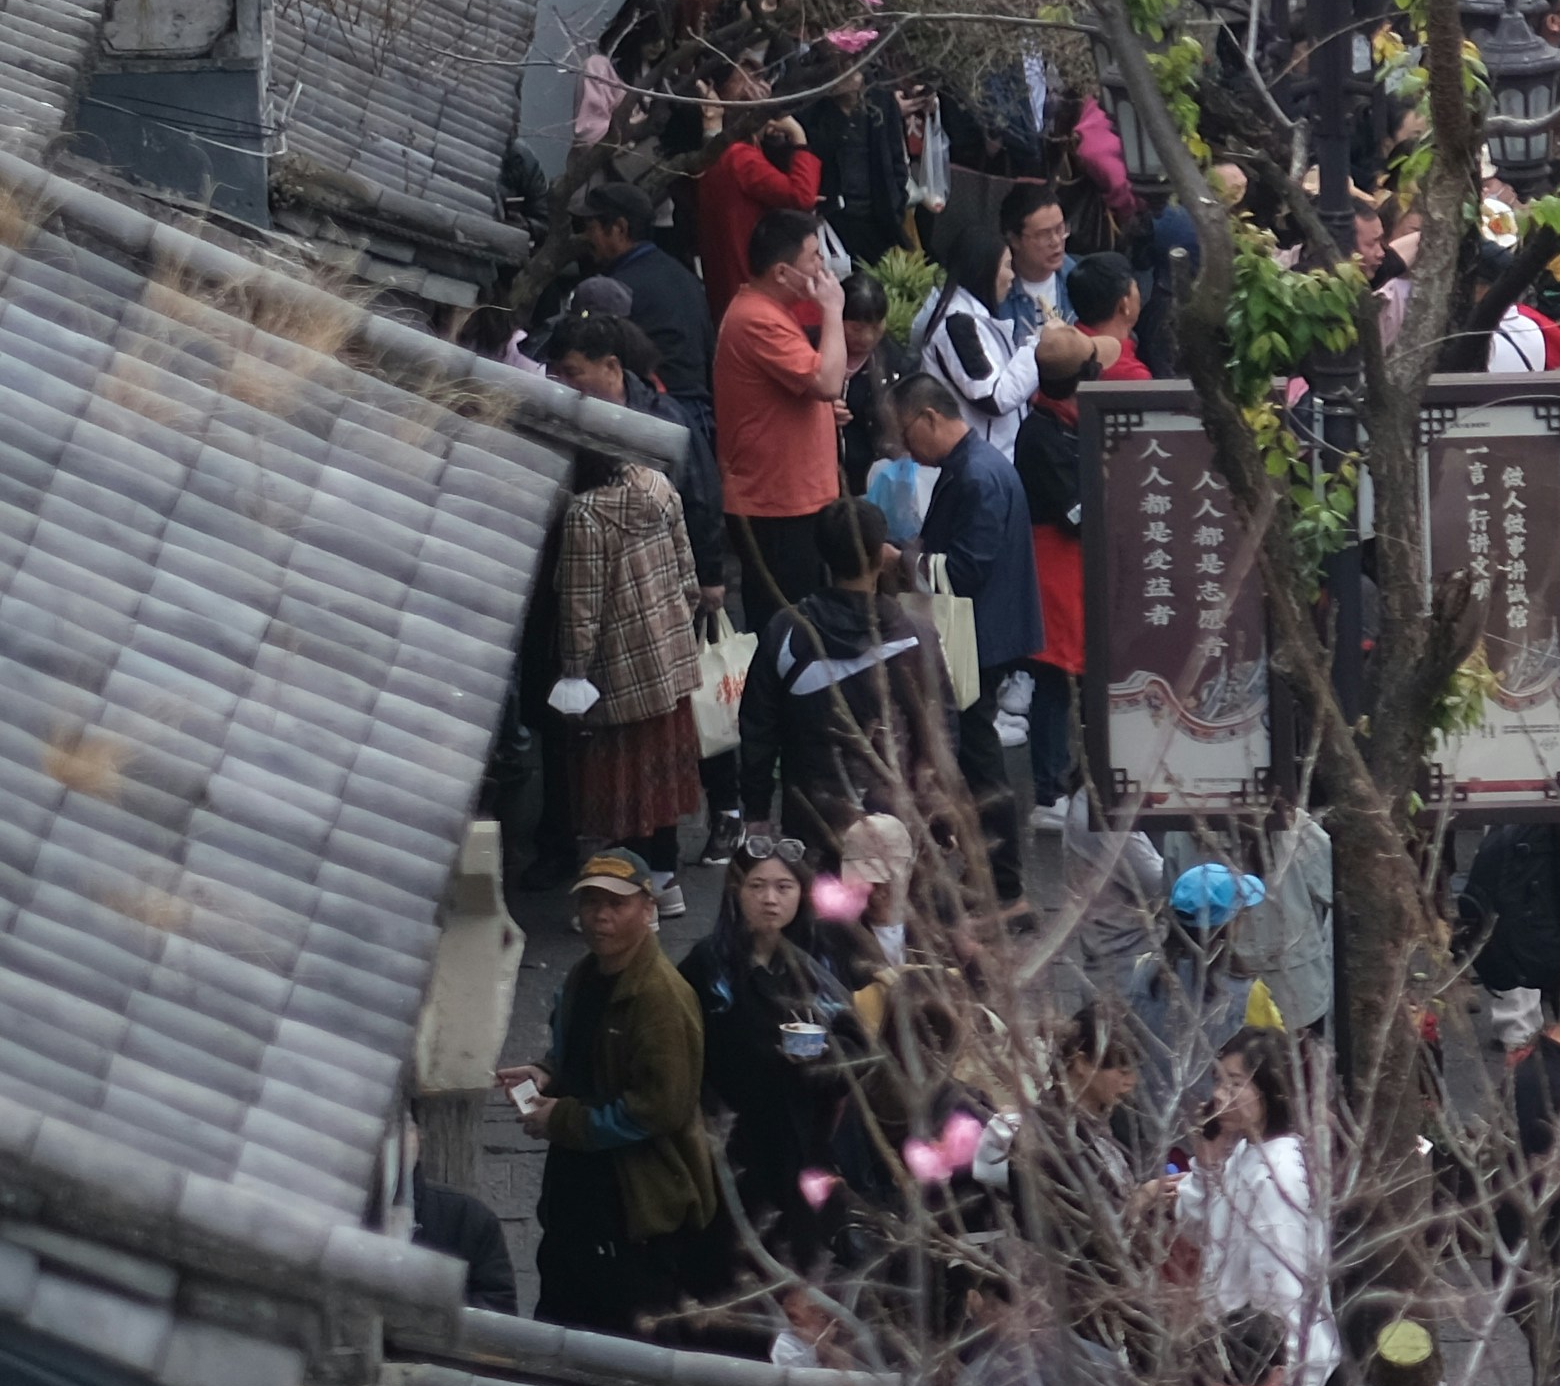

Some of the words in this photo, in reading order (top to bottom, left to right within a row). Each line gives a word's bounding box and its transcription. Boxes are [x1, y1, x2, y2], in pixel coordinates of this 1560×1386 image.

[1140, 438, 1176, 626] 人人都是受益者
[1192, 471, 1229, 658] 人人都是志愿者
[1465, 446, 1492, 601] 一言一行讲文明
[1502, 466, 1528, 628] 做人做事讲诚信
